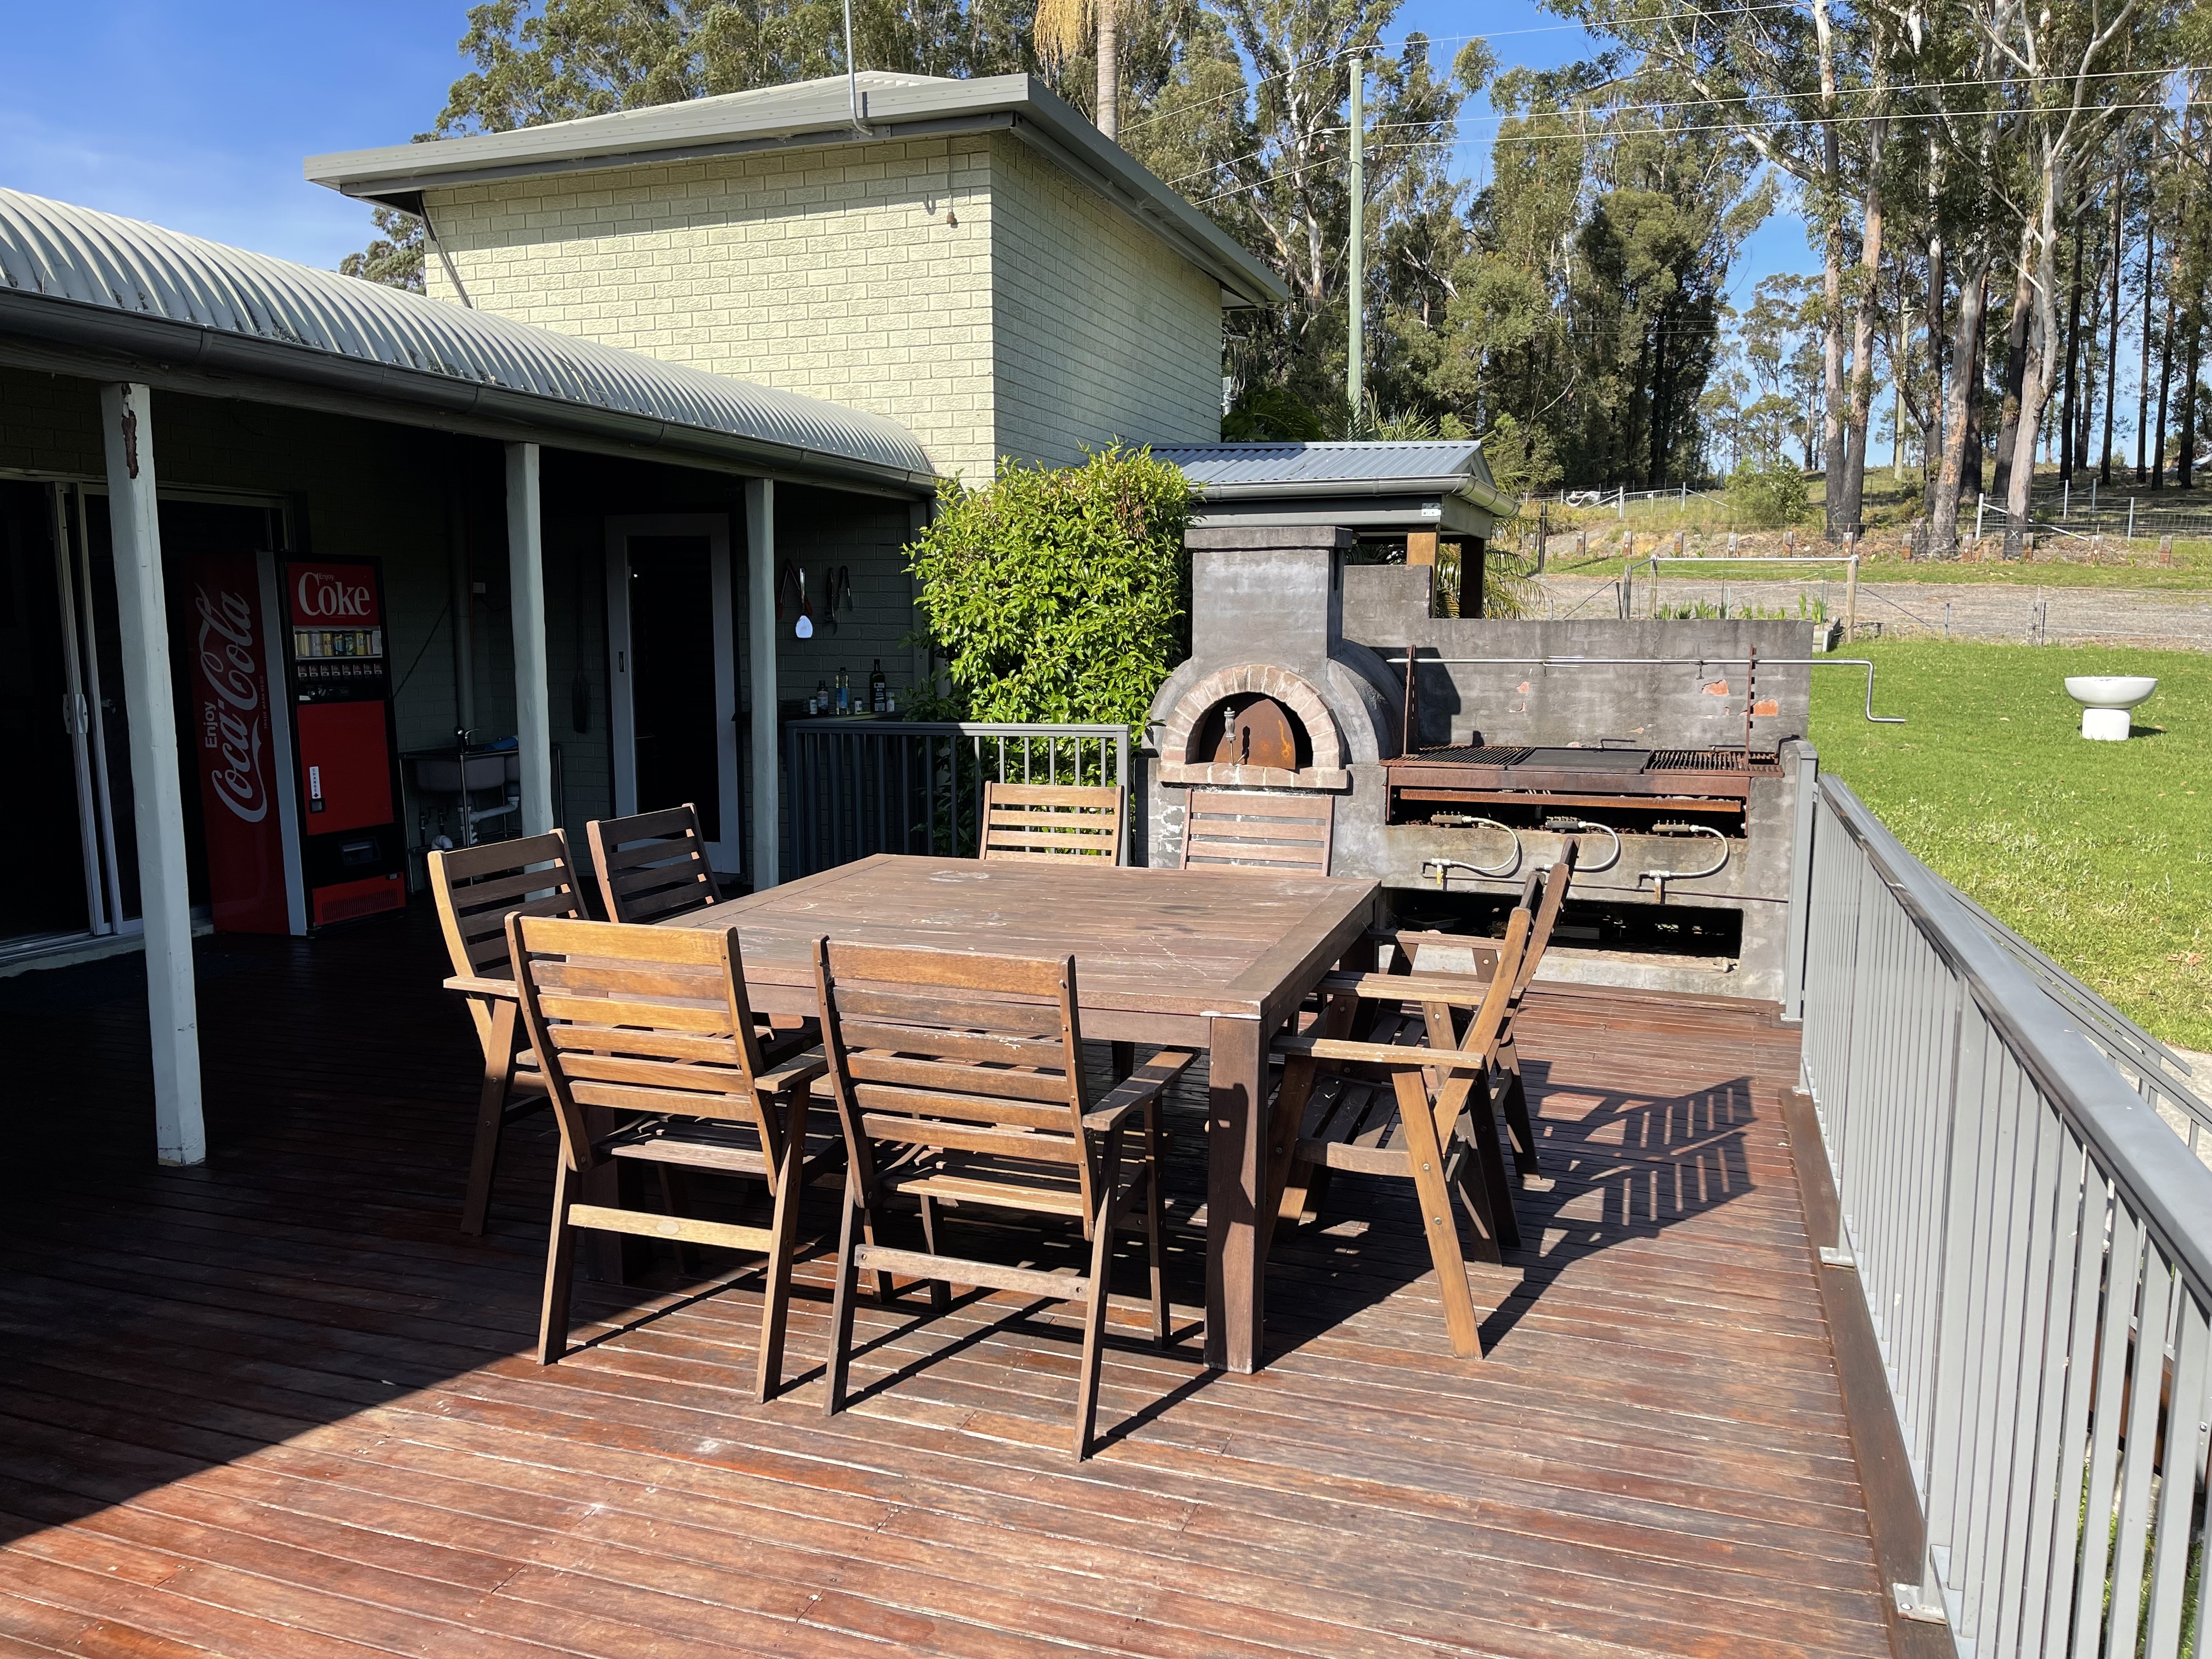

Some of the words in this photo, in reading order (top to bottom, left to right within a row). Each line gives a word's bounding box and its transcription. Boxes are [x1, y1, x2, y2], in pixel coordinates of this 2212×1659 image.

[298, 572, 370, 616] Coke
[319, 573, 335, 581] Enjoy
[195, 583, 267, 822] Coca-Cola
[204, 701, 218, 748] Enjoy
